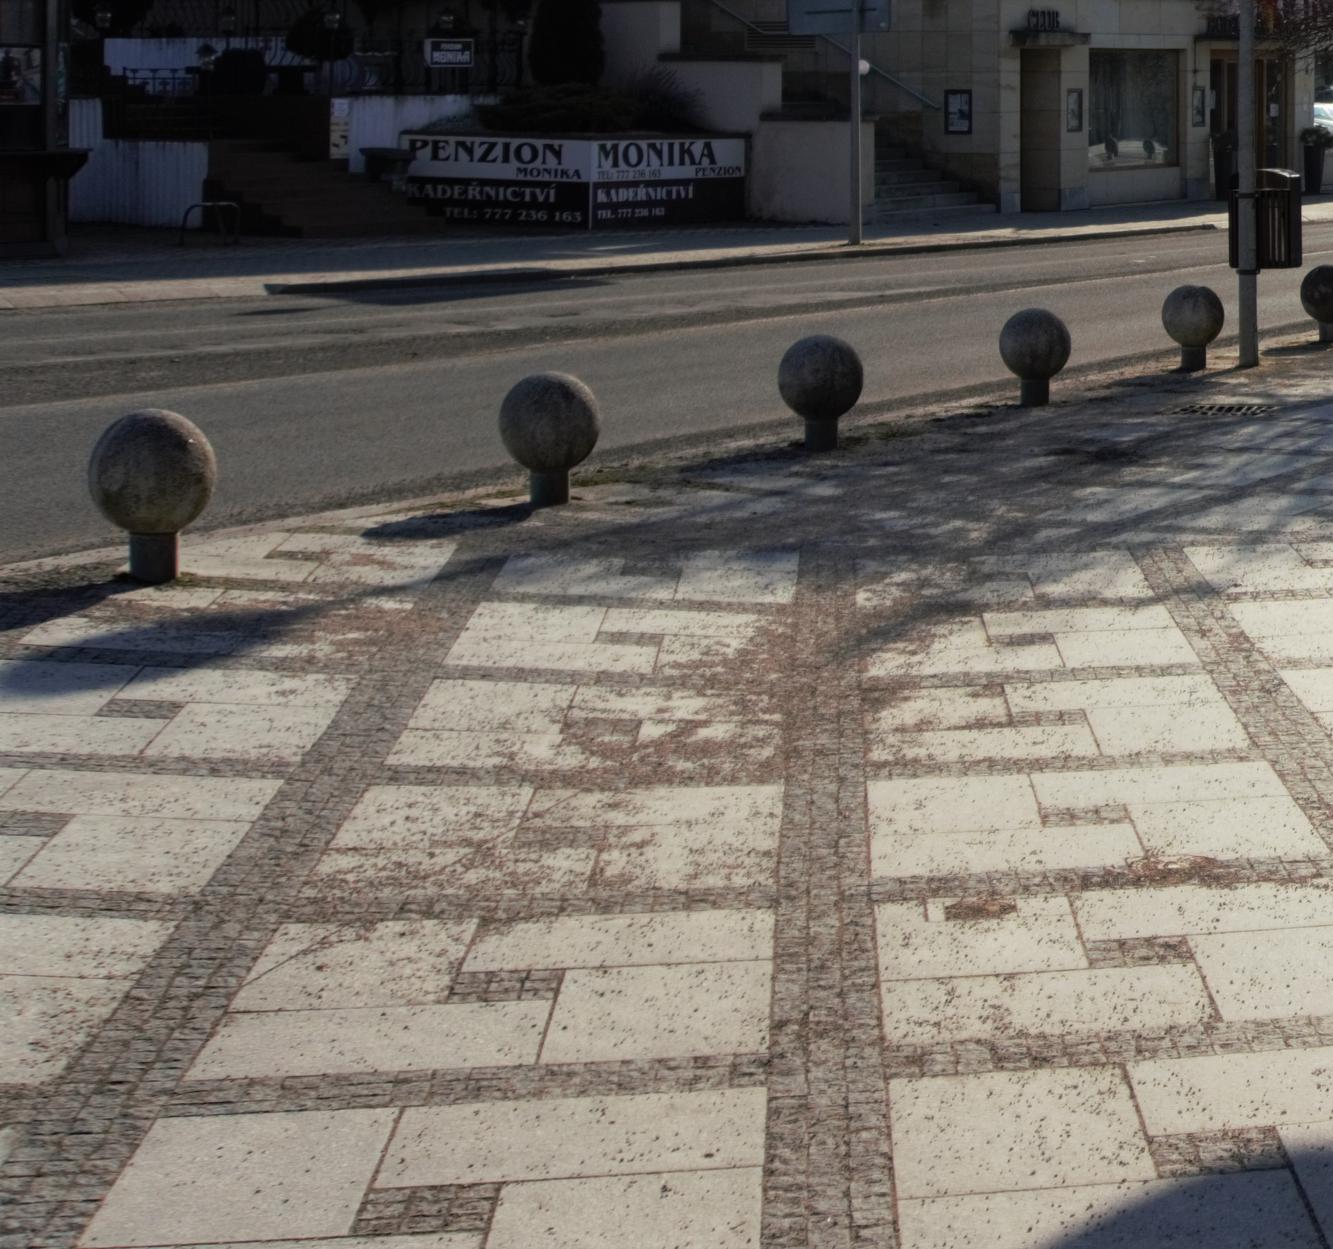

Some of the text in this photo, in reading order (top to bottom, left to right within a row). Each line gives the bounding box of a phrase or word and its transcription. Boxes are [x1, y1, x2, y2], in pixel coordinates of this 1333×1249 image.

[408, 139, 564, 165] PENZION
[597, 141, 717, 168] MONIKA
[516, 167, 582, 180] MONIKA
[616, 170, 630, 179] 777
[695, 166, 742, 177] PENZION
[409, 181, 557, 204] KADEŘNICTVÍ
[596, 182, 695, 203] KADEŘNICTVÍ
[443, 208, 582, 223] TEL: 777 236 163
